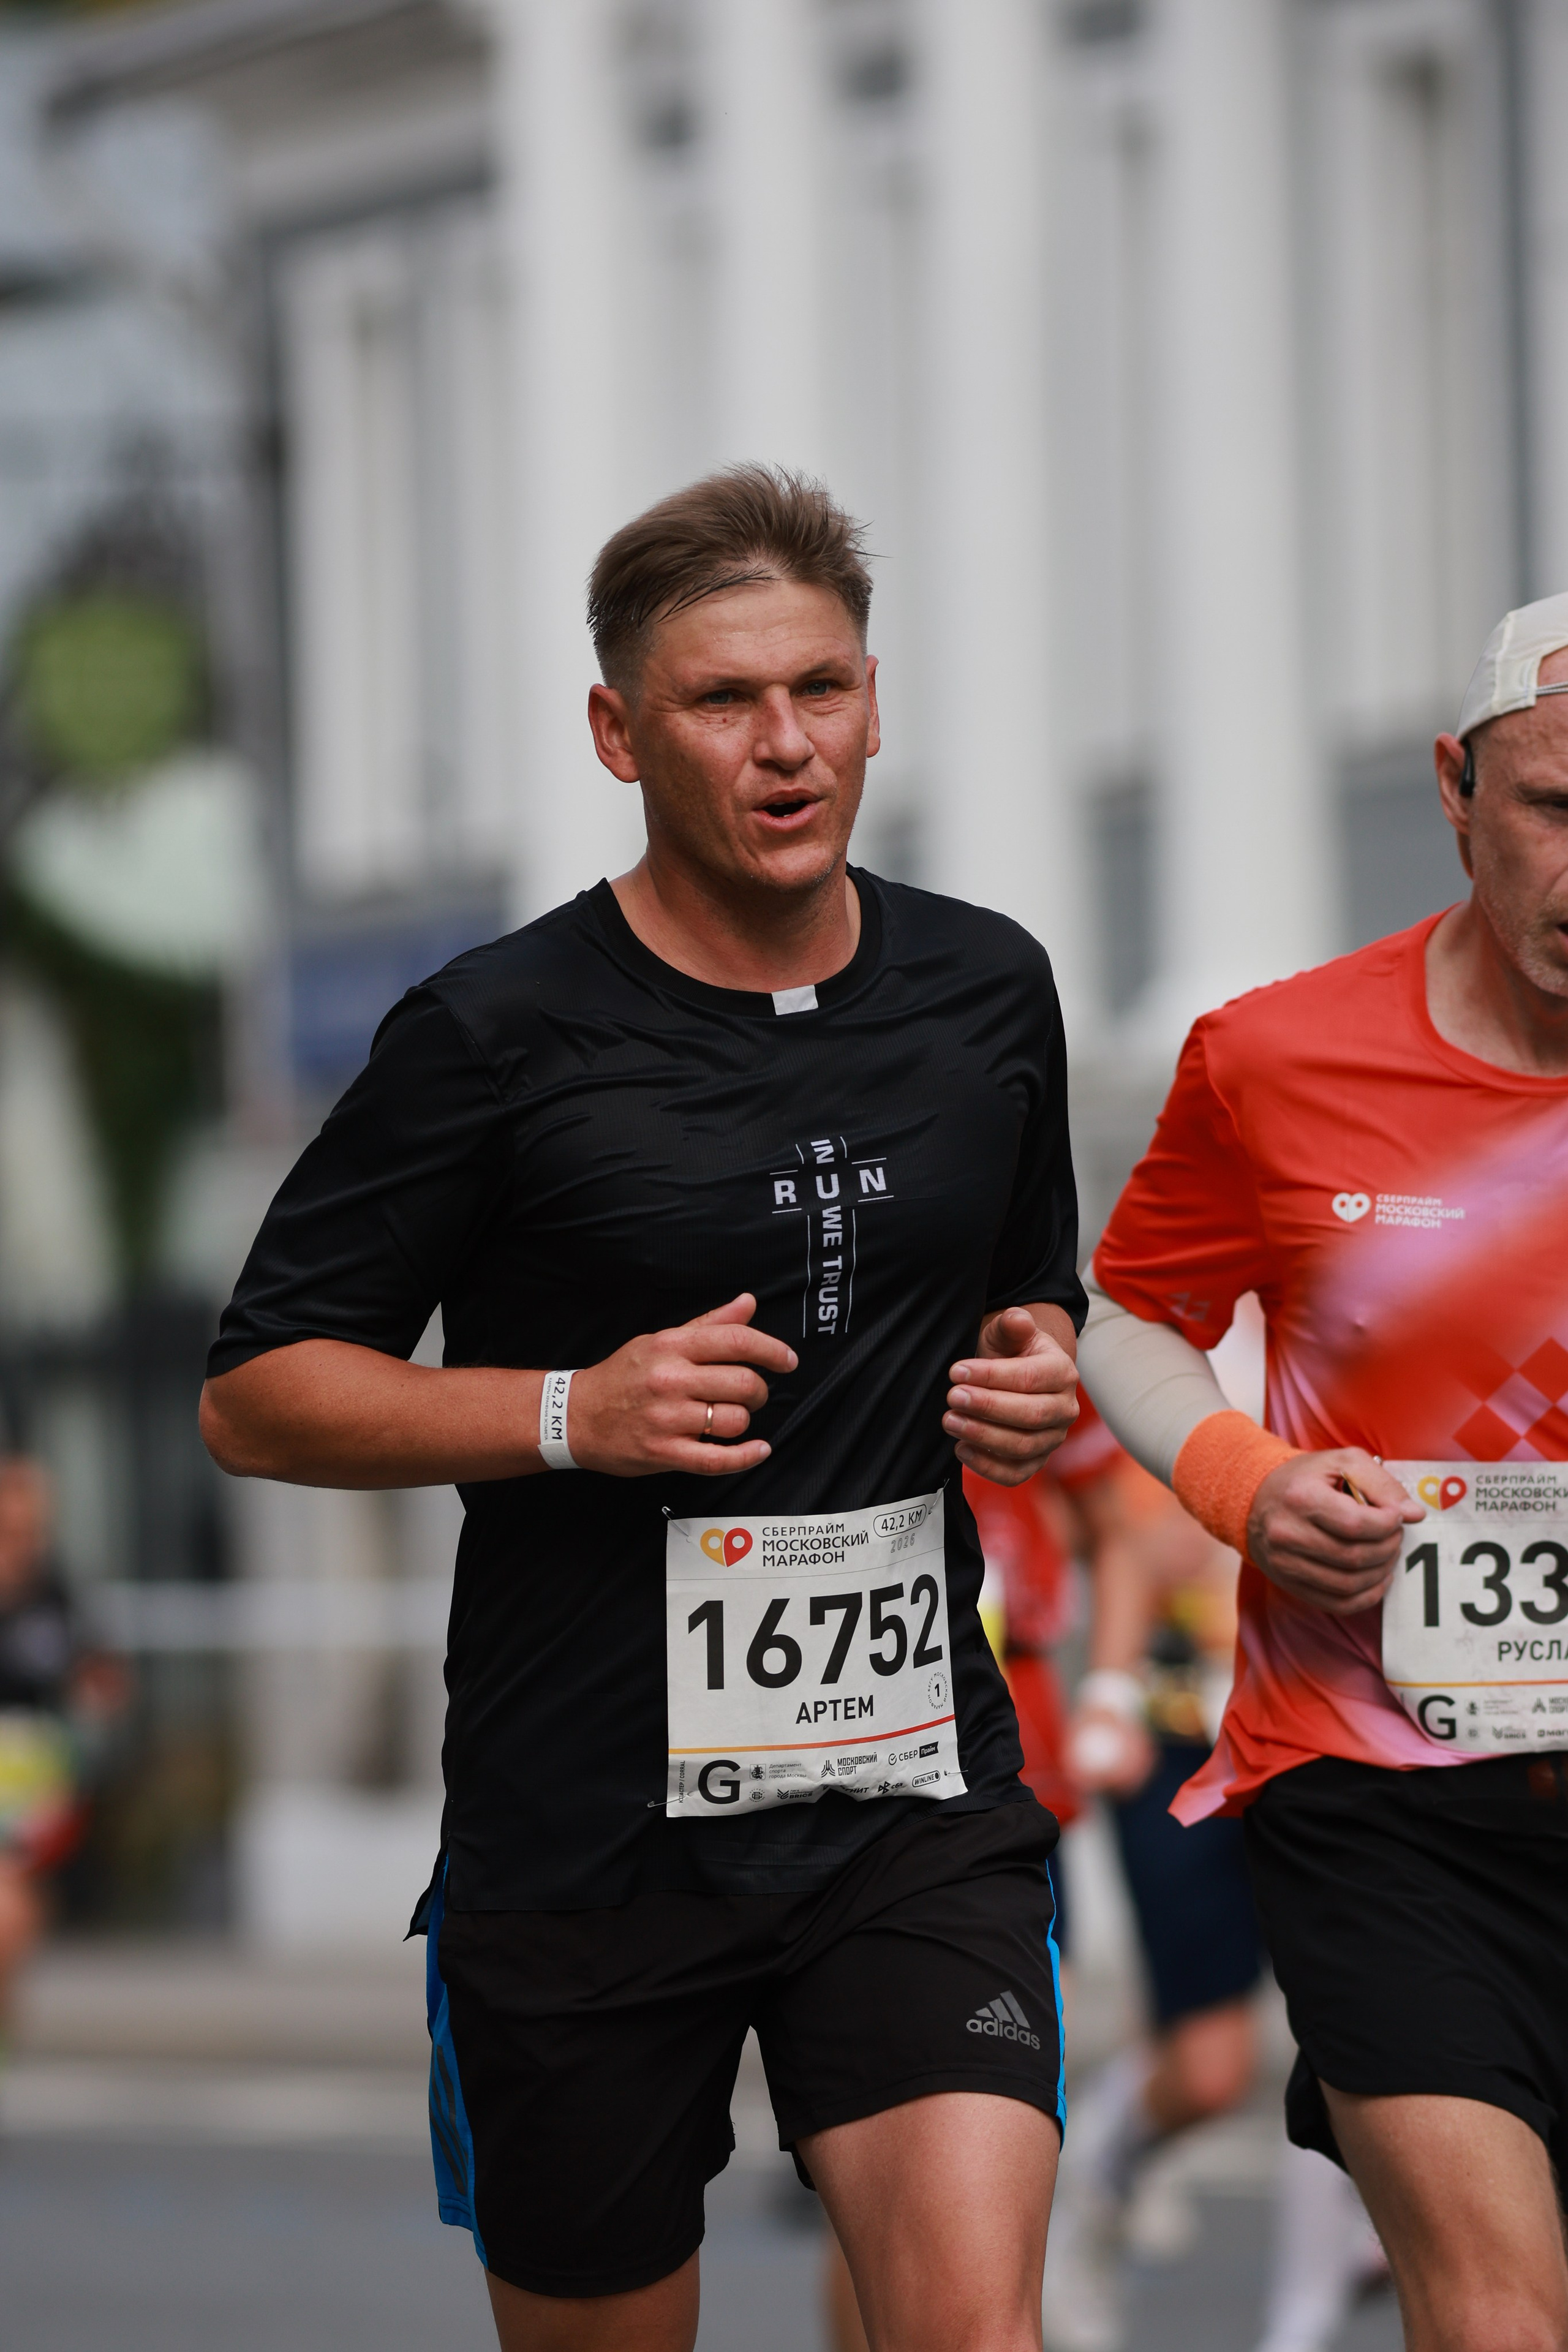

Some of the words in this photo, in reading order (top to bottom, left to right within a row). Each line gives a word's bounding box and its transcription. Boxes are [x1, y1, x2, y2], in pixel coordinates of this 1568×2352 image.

[810, 1139, 835, 1164] IN
[1376, 1194, 1442, 1206] СБЕРПРАЙМ
[1375, 1204, 1466, 1219] МОСКОВСКИЙ
[823, 1205, 843, 1248] WE
[1375, 1214, 1442, 1229] МАРАФОН
[818, 1256, 843, 1335] TRUST
[552, 1377, 566, 1409] 42,2
[1476, 1474, 1556, 1485] СБЕРПРАЙМ
[1476, 1501, 1556, 1512] МАРАФОН
[762, 1523, 845, 1537] СБЕРПРАЙМ
[881, 1515, 905, 1531] 42,2
[763, 1530, 869, 1552] МОСКОВСКИЙ
[890, 1533, 916, 1553] 2026
[763, 1551, 845, 1567] МАРАФОН
[1405, 1540, 1568, 1627] 133
[688, 1574, 943, 1690] 16752
[1498, 1640, 1568, 1662] РУСЛ
[934, 1683, 940, 1697] 1
[796, 1695, 874, 1724] АРТЕМ
[1417, 1694, 1457, 1740] G
[837, 1752, 878, 1767] МОСКОВСКИЙ
[899, 1750, 918, 1762] СБЕР
[838, 1766, 857, 1776] СПОРТ
[914, 1774, 935, 1786] WINLINE
[698, 1759, 741, 1804] G
[966, 2018, 1040, 2050] adidas
